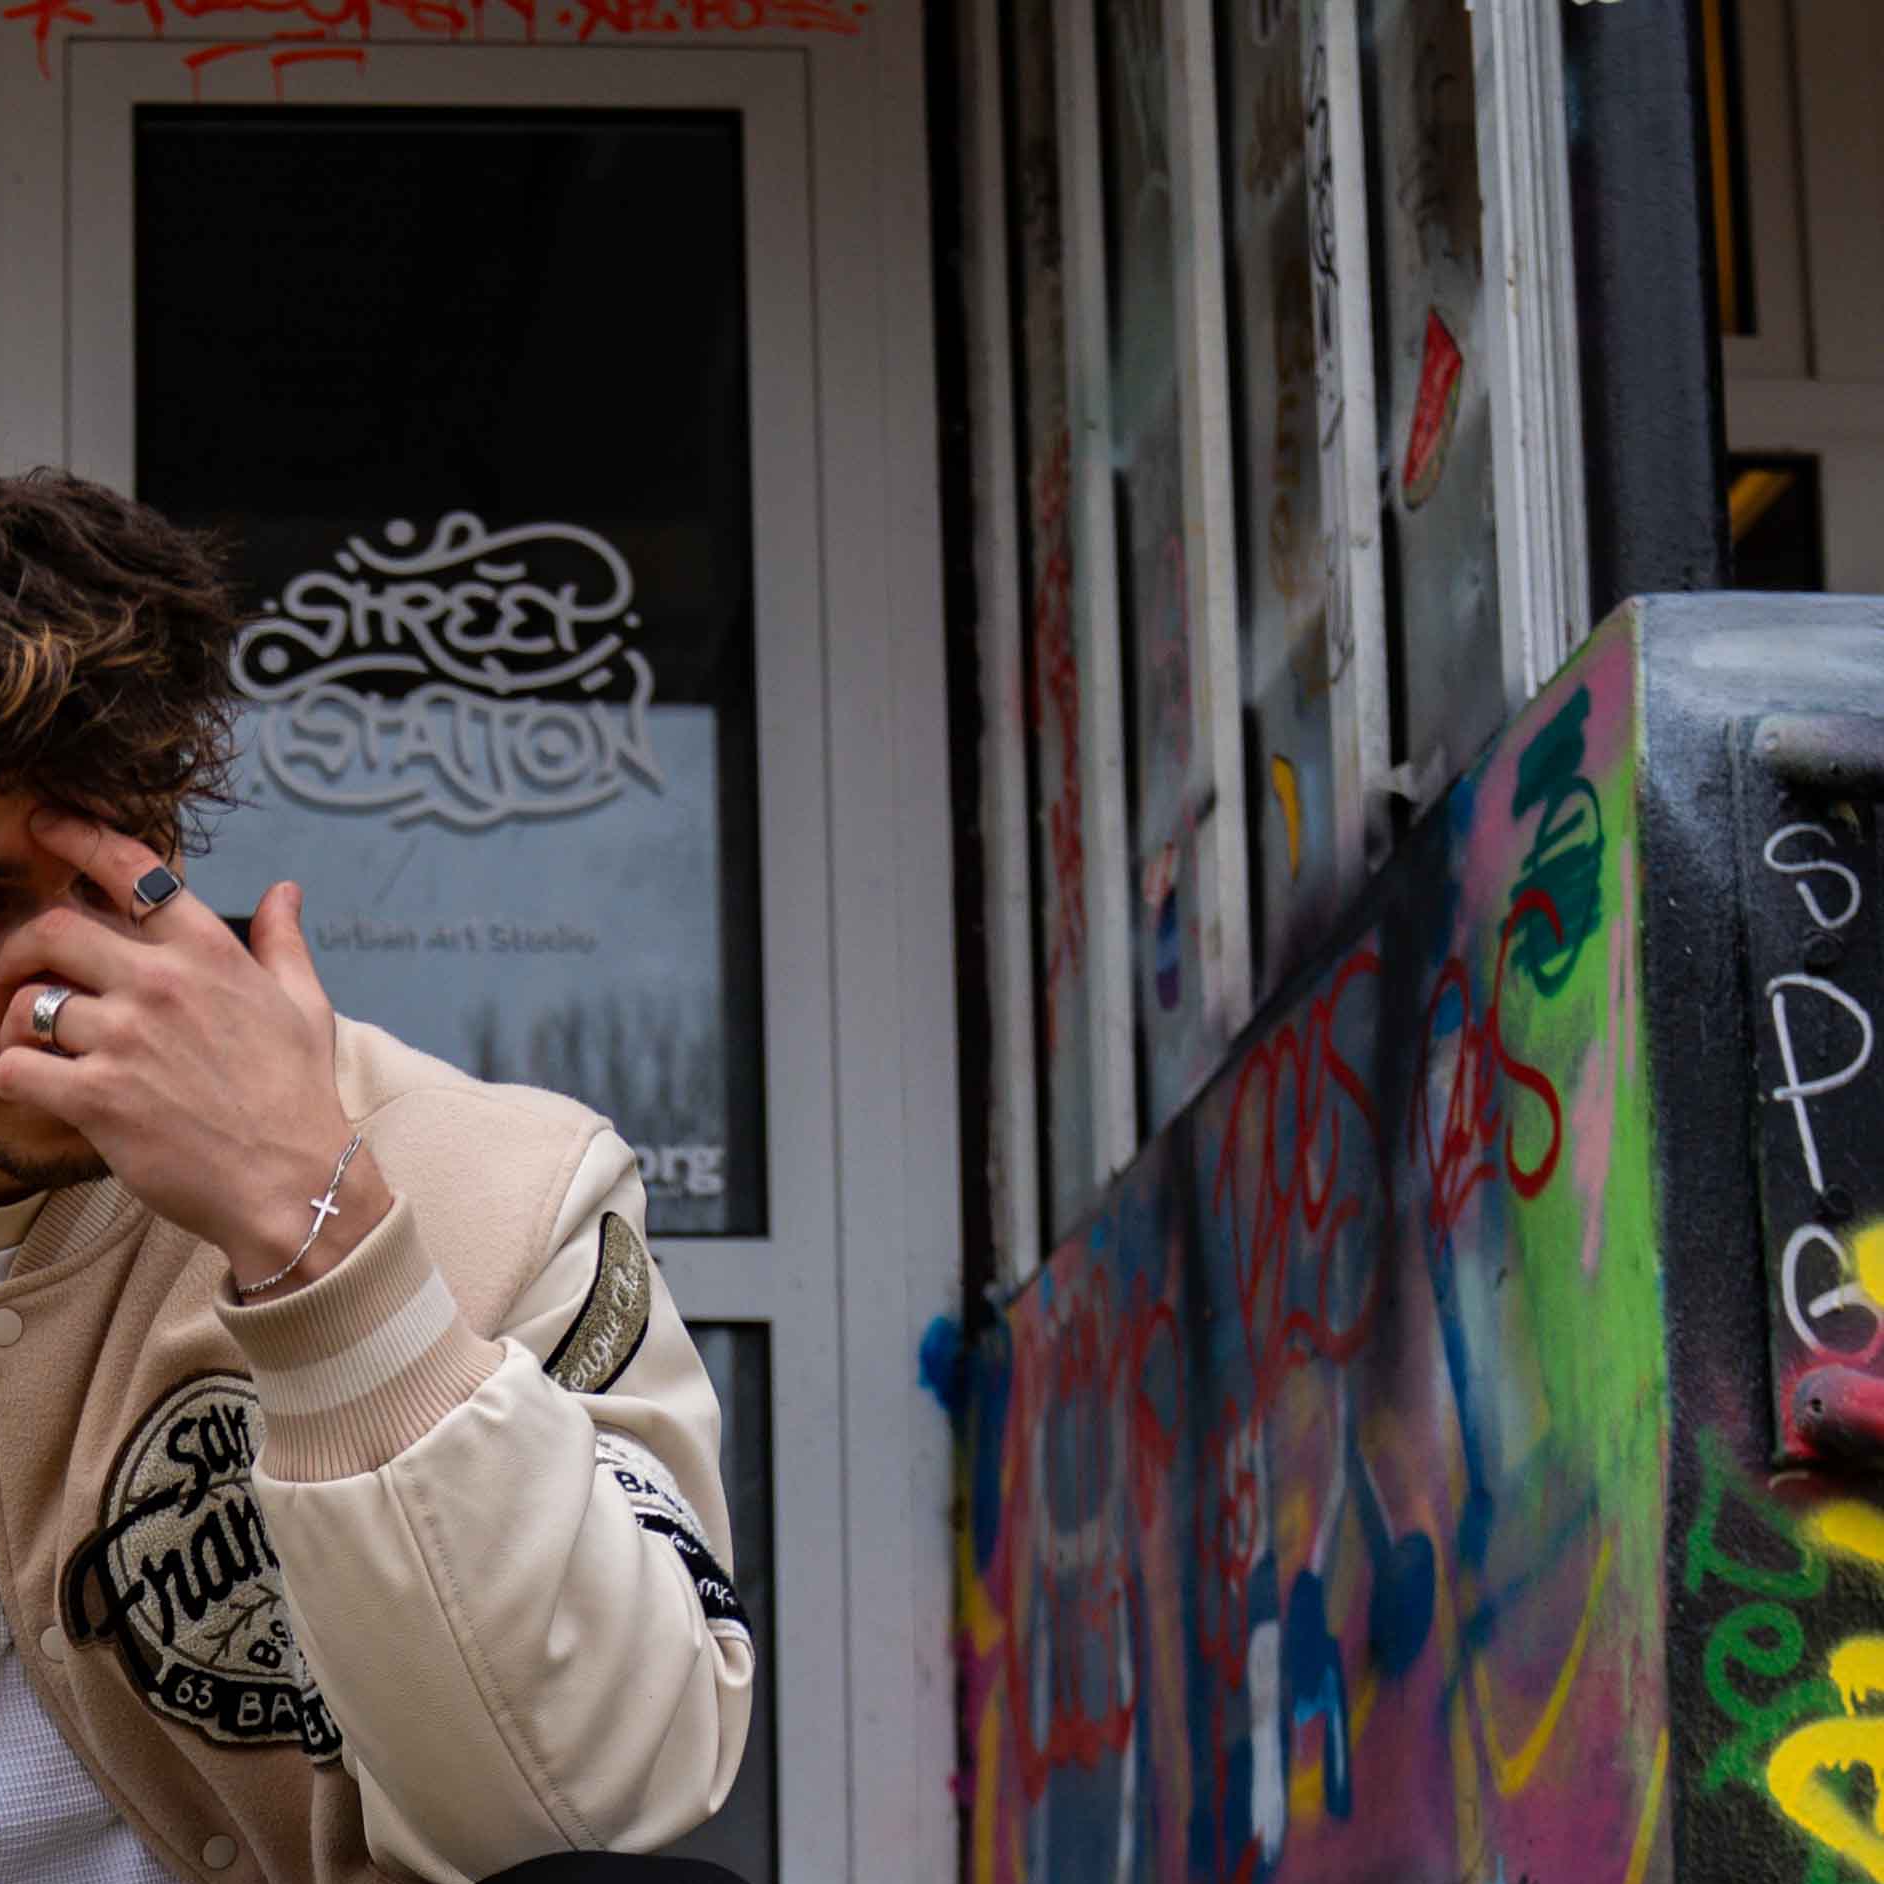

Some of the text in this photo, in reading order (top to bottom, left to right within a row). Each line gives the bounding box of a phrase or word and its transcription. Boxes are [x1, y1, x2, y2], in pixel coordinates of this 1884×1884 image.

[318, 921, 597, 953] Urban Art Studio
[175, 1675, 213, 1709] 63
